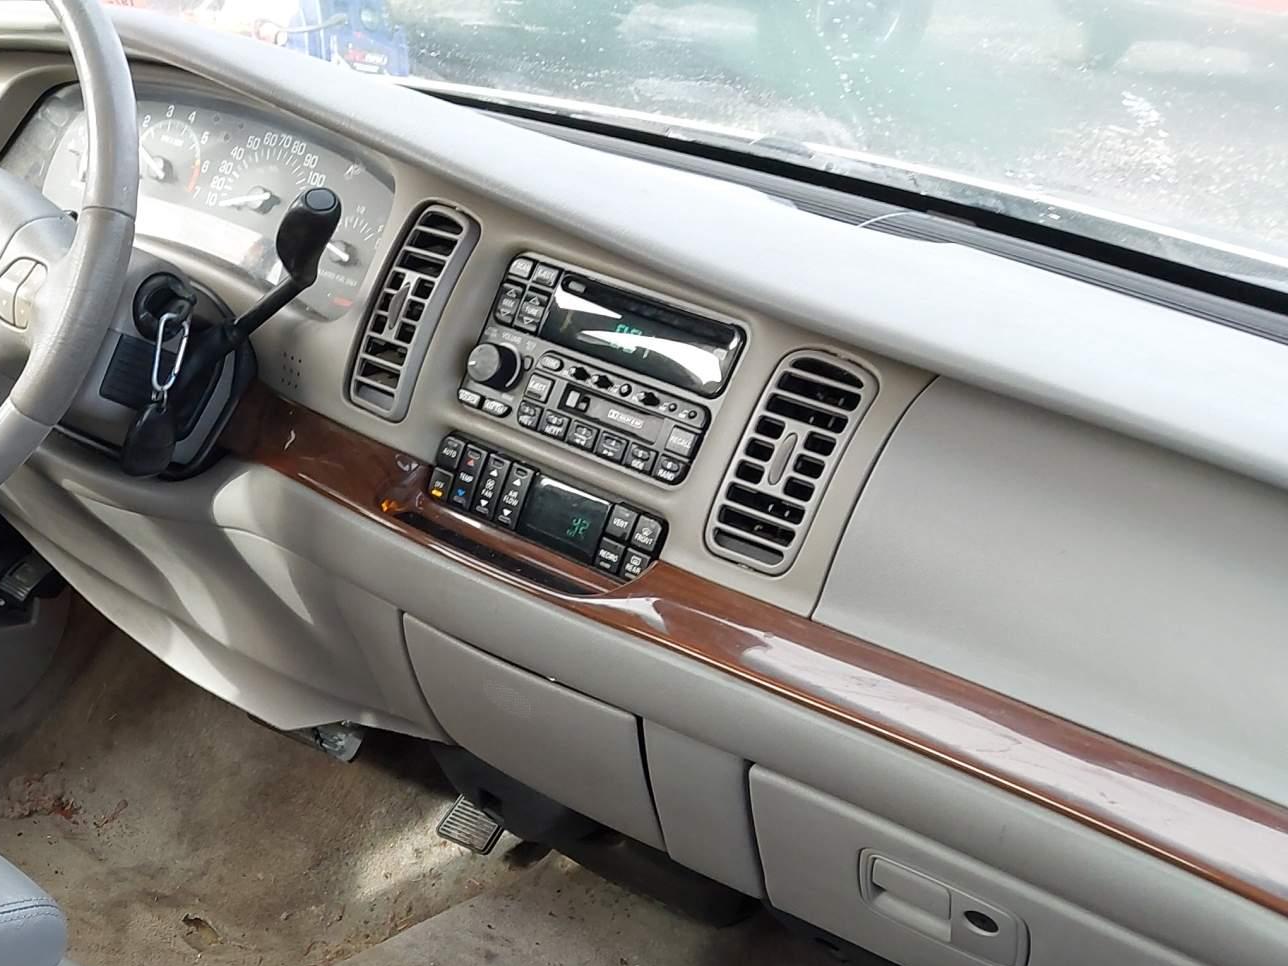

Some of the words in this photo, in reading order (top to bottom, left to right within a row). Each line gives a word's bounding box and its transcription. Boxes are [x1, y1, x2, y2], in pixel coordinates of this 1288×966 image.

[166, 105, 174, 118] 3
[188, 111, 196, 123] 4
[143, 115, 151, 128] 2
[246, 135, 261, 149] 50
[263, 132, 278, 147] 60
[279, 134, 293, 148] 70
[230, 146, 244, 161] 40
[291, 141, 306, 156] 80
[219, 160, 233, 174] 30
[303, 153, 318, 168] 90
[210, 176, 225, 191] 20
[307, 171, 325, 187] 100
[205, 193, 217, 206] 10
[443, 447, 457, 459] AUTO
[459, 472, 474, 483] TEMP
[481, 488, 494, 499] FAN
[503, 494, 519, 507] FLOW
[634, 532, 654, 546] FRONT
